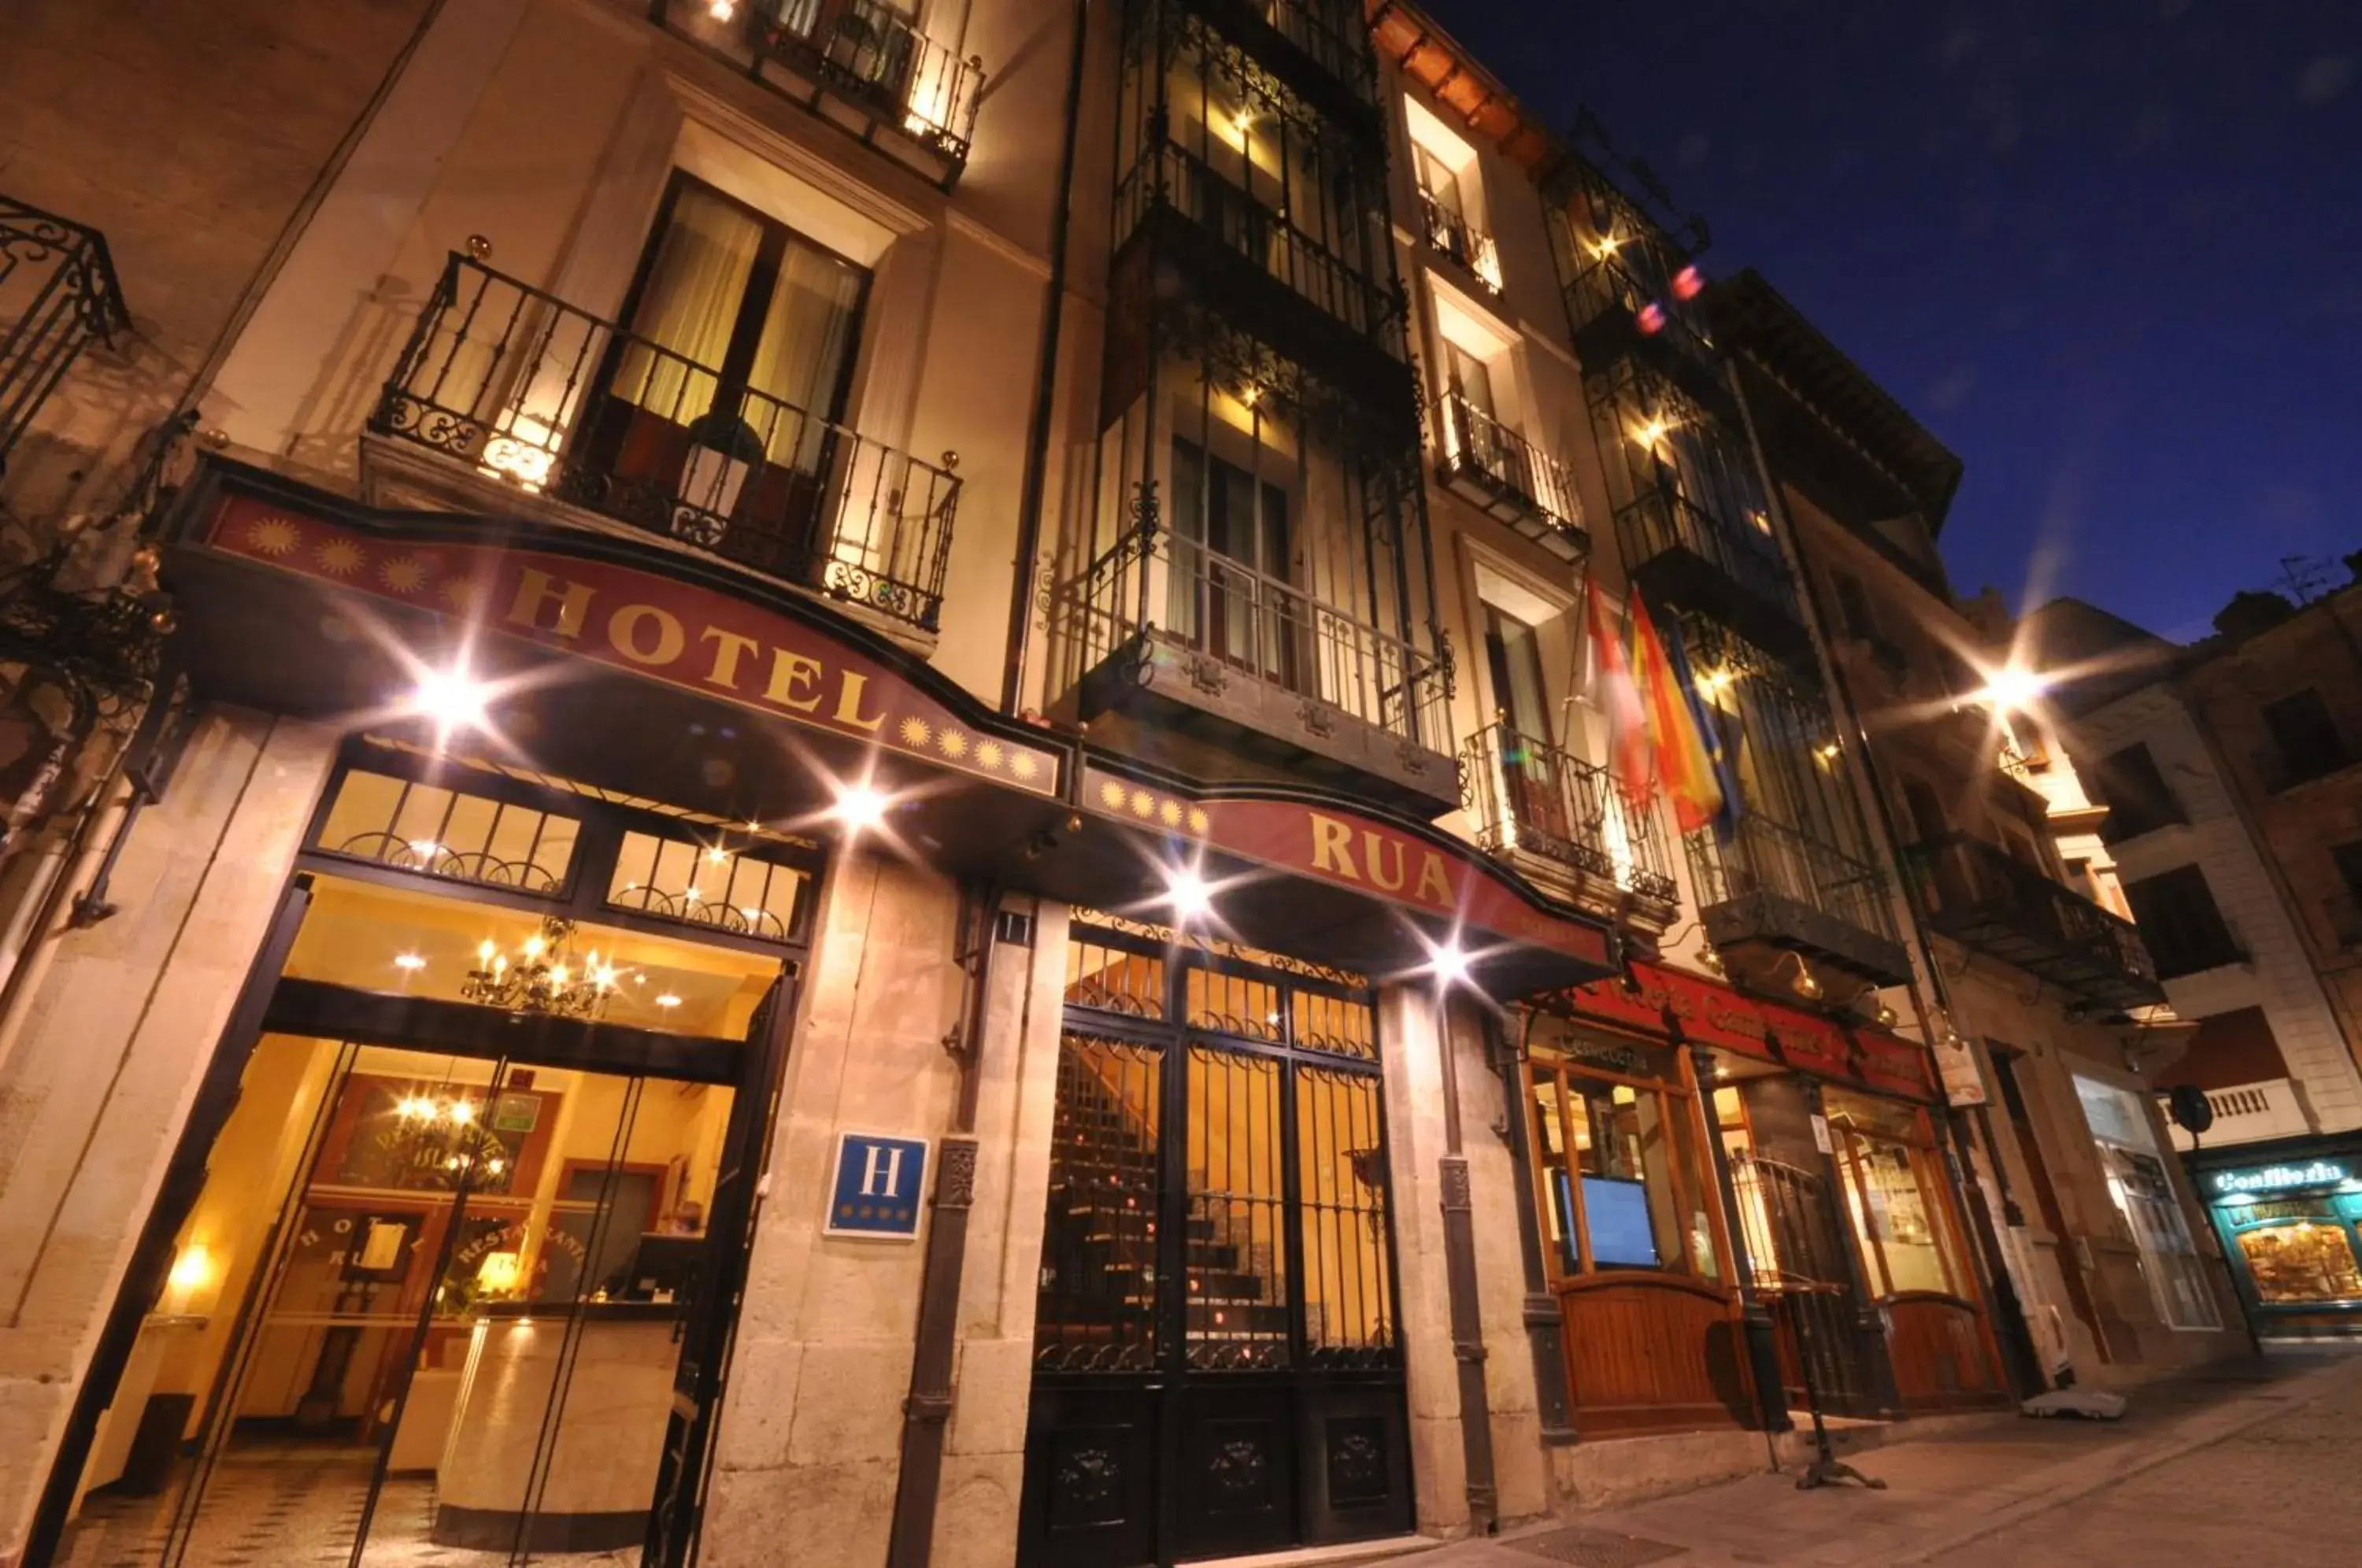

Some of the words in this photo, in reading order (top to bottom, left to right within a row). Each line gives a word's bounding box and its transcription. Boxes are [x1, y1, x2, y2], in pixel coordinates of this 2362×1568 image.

[508, 567, 887, 732] HOTEL
[1309, 811, 1457, 908] RUA
[858, 1145, 904, 1197] H
[300, 1216, 425, 1252] HOTL
